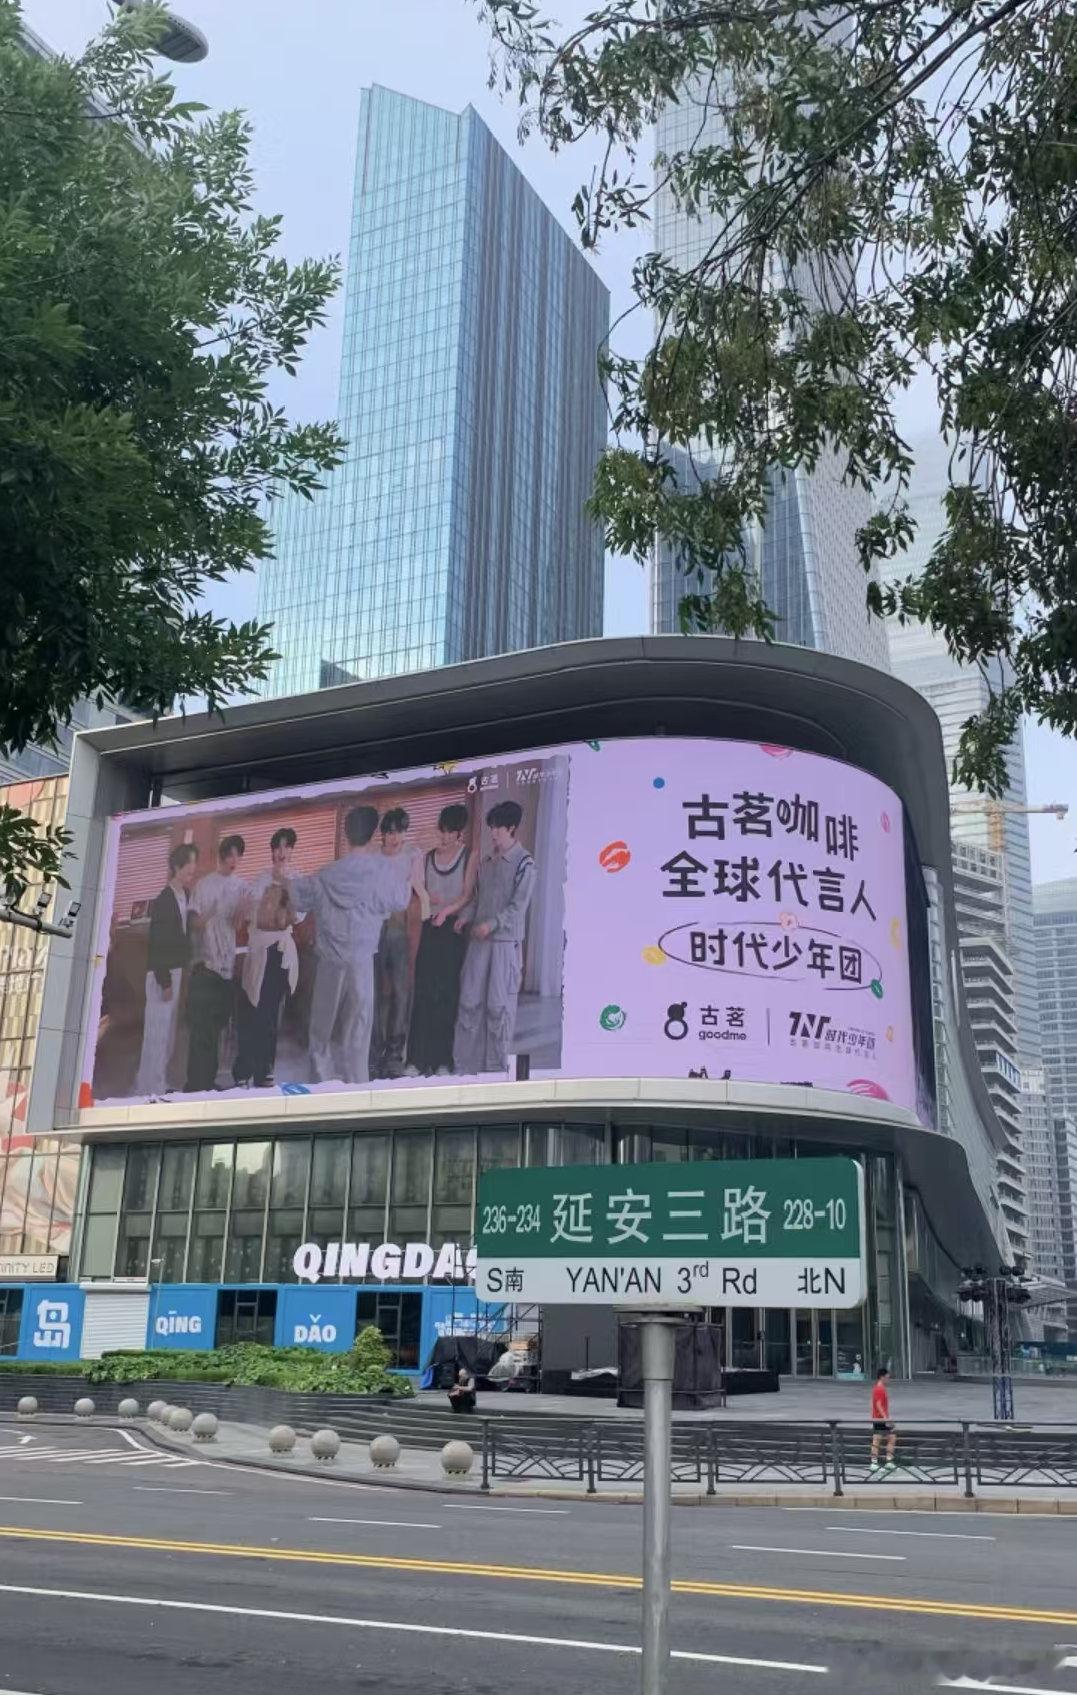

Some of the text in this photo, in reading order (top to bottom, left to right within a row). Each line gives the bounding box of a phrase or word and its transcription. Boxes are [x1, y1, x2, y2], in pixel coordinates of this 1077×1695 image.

[682, 791, 859, 861] 古茗咖啡
[660, 850, 877, 921] 全球代言人
[689, 928, 863, 984] 时代少年团
[699, 1030, 747, 1041] goodme
[700, 1005, 745, 1027] 古茗
[482, 1185, 847, 1244] 236-234 延安三路 228-10
[486, 1260, 846, 1294] S南 YAN'AN 3rd Rd 北N
